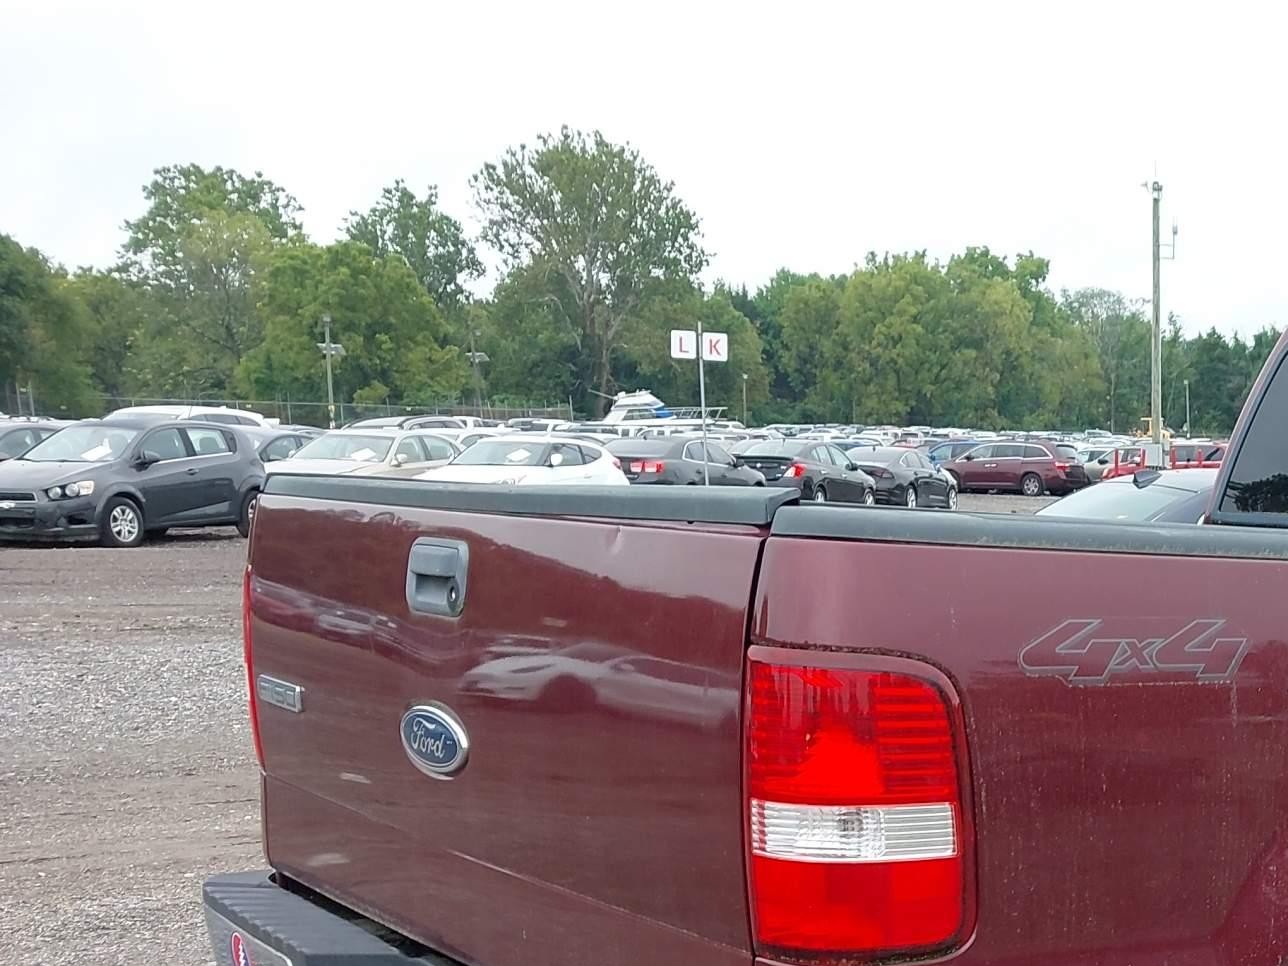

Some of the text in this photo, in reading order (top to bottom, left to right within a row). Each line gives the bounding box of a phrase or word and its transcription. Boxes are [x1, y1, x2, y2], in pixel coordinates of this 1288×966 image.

[679, 335, 690, 354] L
[708, 338, 722, 357] K
[1017, 618, 1248, 685] 4x4
[411, 717, 446, 759] Ford
